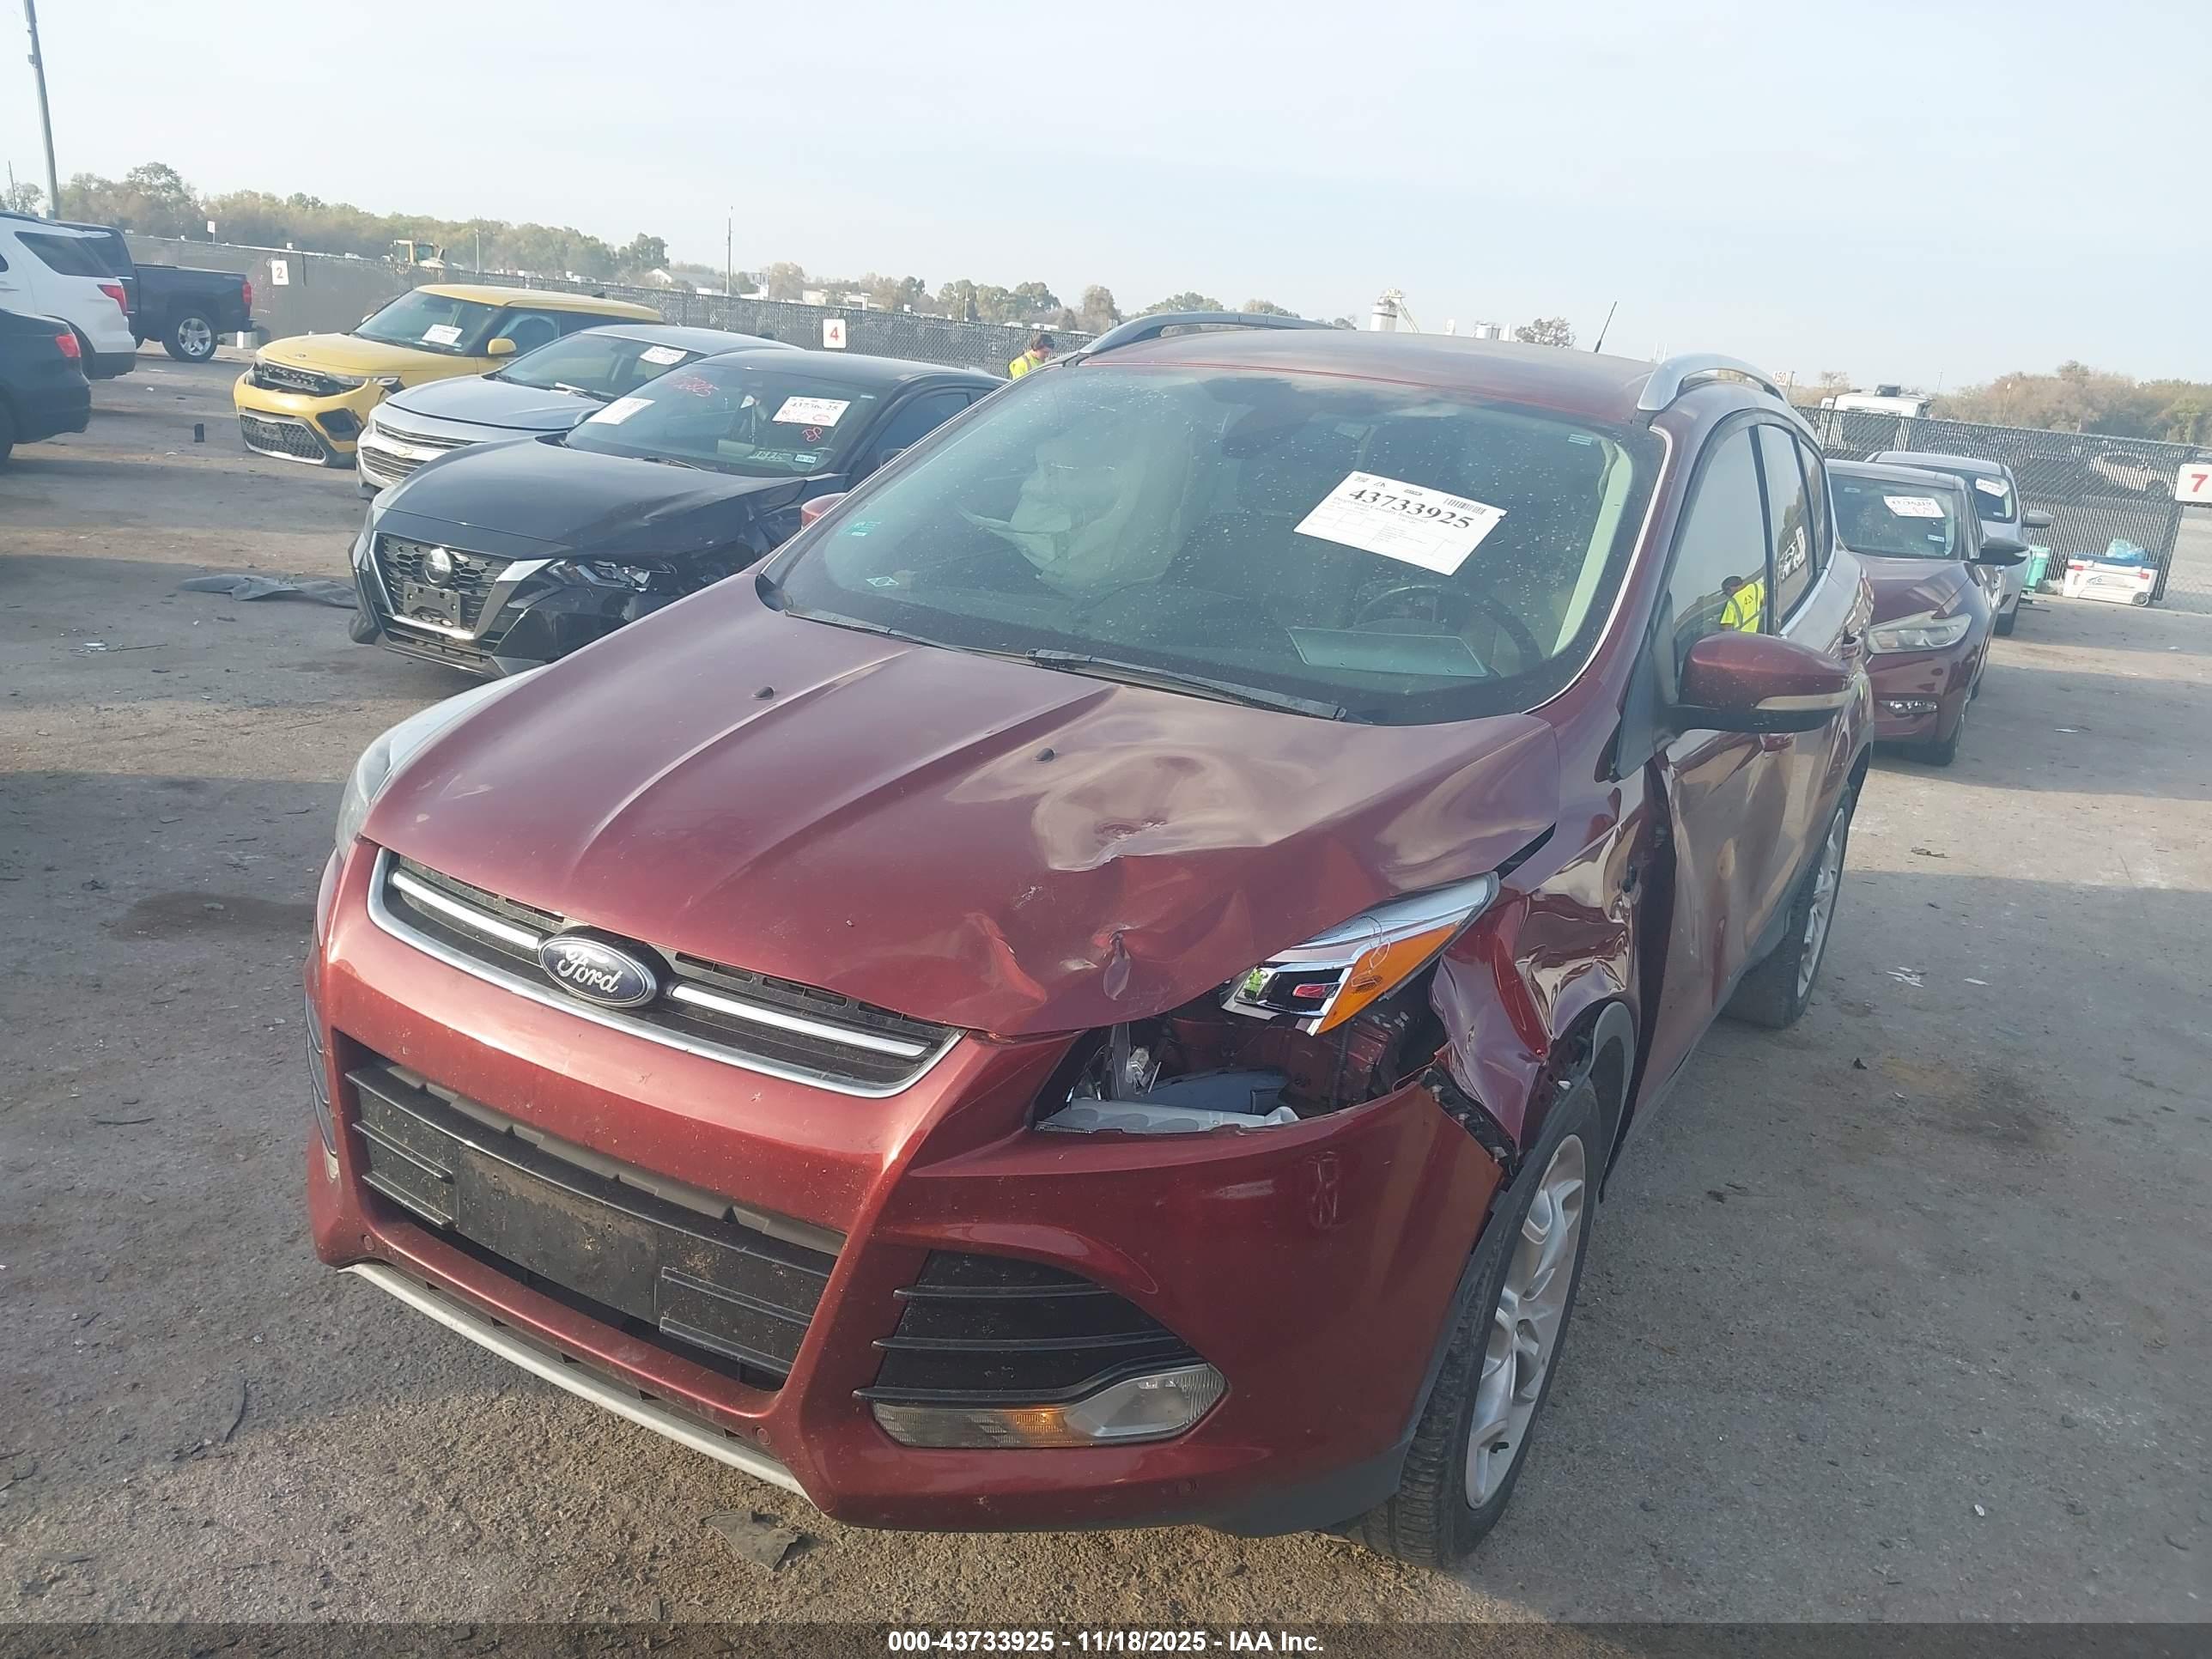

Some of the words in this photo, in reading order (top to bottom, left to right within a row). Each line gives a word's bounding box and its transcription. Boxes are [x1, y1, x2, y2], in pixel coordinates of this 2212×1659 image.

[276, 266, 283, 279] 2
[830, 326, 840, 341] 4
[2191, 473, 2209, 493] 7
[1349, 489, 1474, 529] 43733925
[556, 945, 623, 994] Ford
